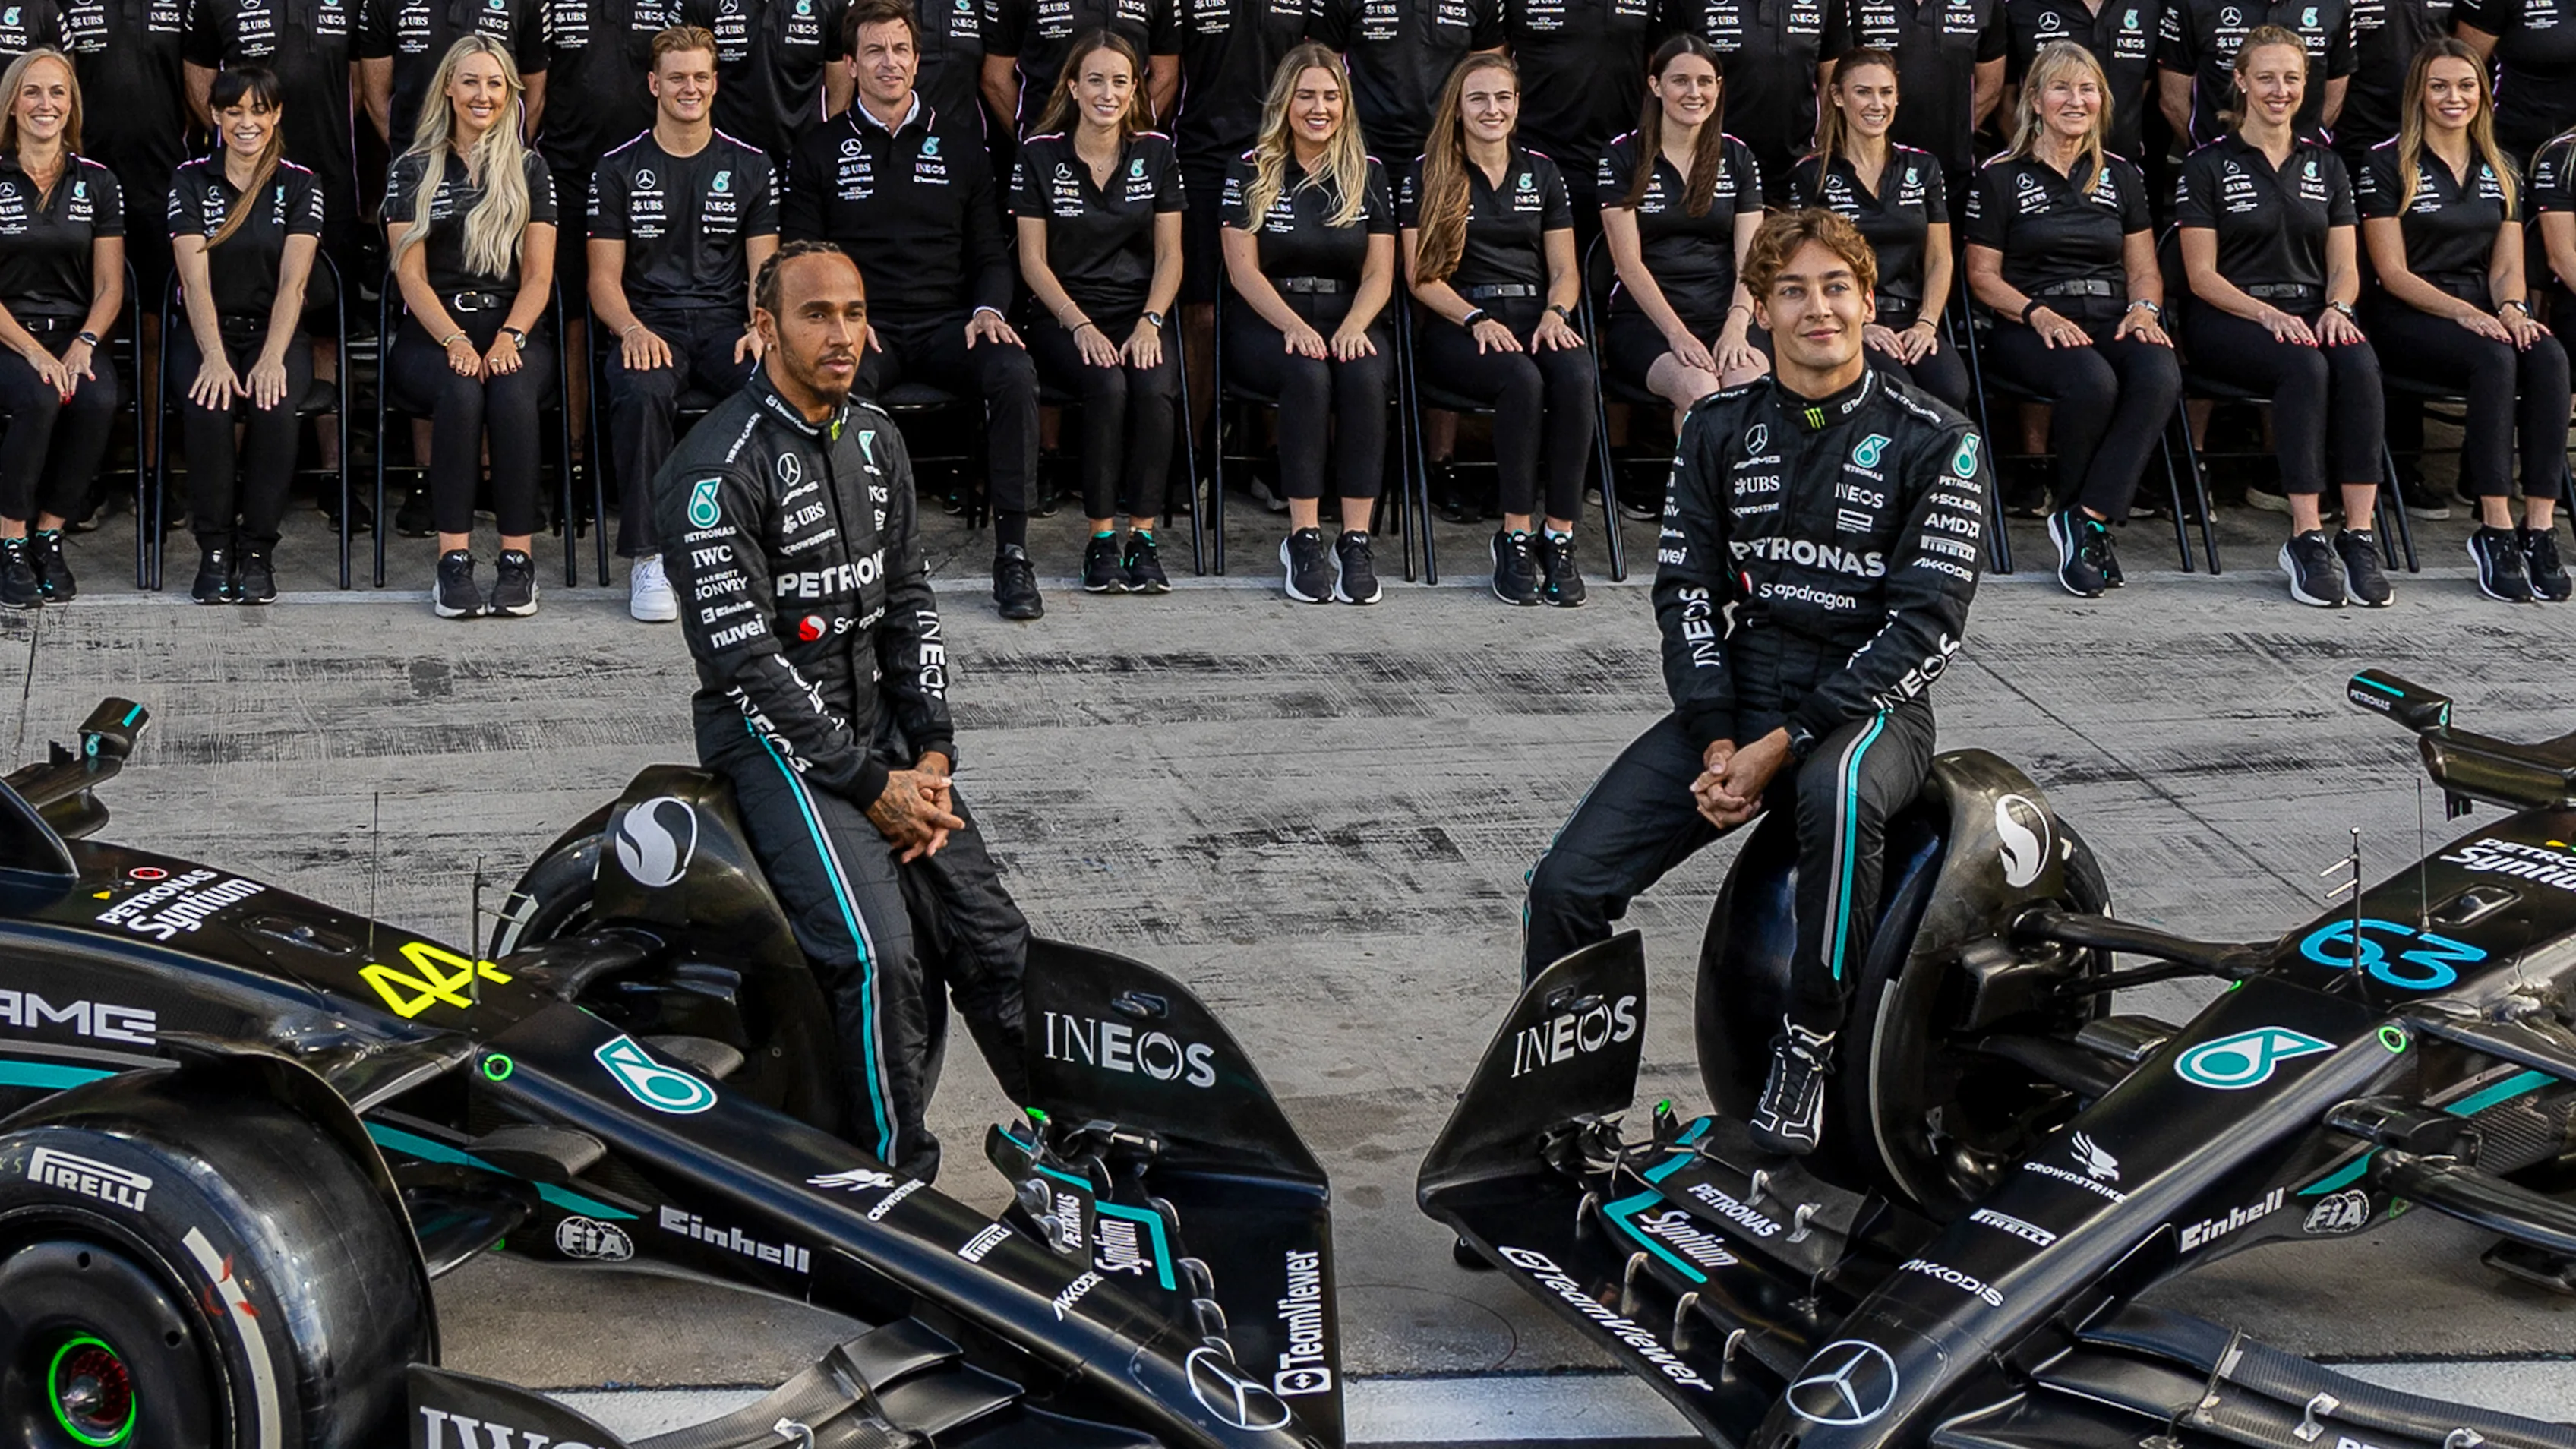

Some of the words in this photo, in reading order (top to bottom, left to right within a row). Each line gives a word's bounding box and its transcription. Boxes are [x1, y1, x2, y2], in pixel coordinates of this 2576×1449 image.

[1050, 2, 1070, 11] UBS
[1439, 5, 1467, 17] INEOS
[82, 14, 104, 26] UBS
[150, 11, 181, 22] INEOS
[250, 18, 271, 30] UBS
[318, 14, 346, 26] INEOS
[408, 14, 428, 26] UBS
[478, 17, 509, 30] INEOS
[566, 11, 587, 21] UBS
[635, 11, 665, 21] INEOS
[951, 18, 979, 30] INEOS
[1718, 15, 1739, 25] UBS
[1790, 13, 1820, 24] INEOS
[1874, 15, 1896, 25] UBS
[1945, 14, 1975, 24] INEOS
[724, 24, 745, 34] UBS
[788, 24, 819, 35] INEOS
[0, 35, 27, 46] NEOS
[2117, 37, 2145, 49] INEOS
[2306, 36, 2326, 47] EOS
[851, 163, 871, 174] UBS
[915, 163, 946, 175] INEOS
[1125, 182, 1153, 194] INEOS
[1716, 181, 1735, 190] EOS
[643, 200, 664, 210] UBS
[705, 200, 737, 212] INEOS
[1514, 194, 1541, 204] INEOS
[70, 204, 93, 214] INEOS
[1747, 475, 1780, 493] UBS
[1834, 482, 1885, 510] INEOS
[796, 501, 826, 526] UBS
[1924, 513, 1969, 533] AMD
[684, 526, 737, 543] PETRONAS
[690, 545, 733, 569] IWC
[777, 548, 886, 598] PETRON
[1759, 582, 1857, 610] Sapdragon
[710, 613, 766, 649] nuvei
[1678, 586, 1721, 668] INEOS
[1871, 632, 1962, 710] INEOS
[2474, 838, 2576, 868] PETRO
[96, 869, 219, 926] PETRONAS
[126, 878, 266, 941] Syntium
[2300, 918, 2488, 990] 63
[358, 942, 513, 1019] 44
[1511, 995, 1638, 1078] INEOS
[1043, 1011, 1217, 1088] INEOS
[27, 1146, 153, 1212] PIRELLI
[2024, 1161, 2127, 1204] CROWDSTRIKE
[1687, 1182, 1782, 1239] PETRONAS
[1970, 1208, 2057, 1247] PIRELLI
[2180, 1187, 2285, 1254] Einhell
[660, 1204, 810, 1274] Einhell
[958, 1223, 1013, 1264] PIRELLI
[1638, 1210, 1739, 1269] Syntium
[1278, 1249, 1325, 1370] TeamViewer
[1533, 1264, 1714, 1392] TeamViewer
[419, 1406, 605, 1449] IW
